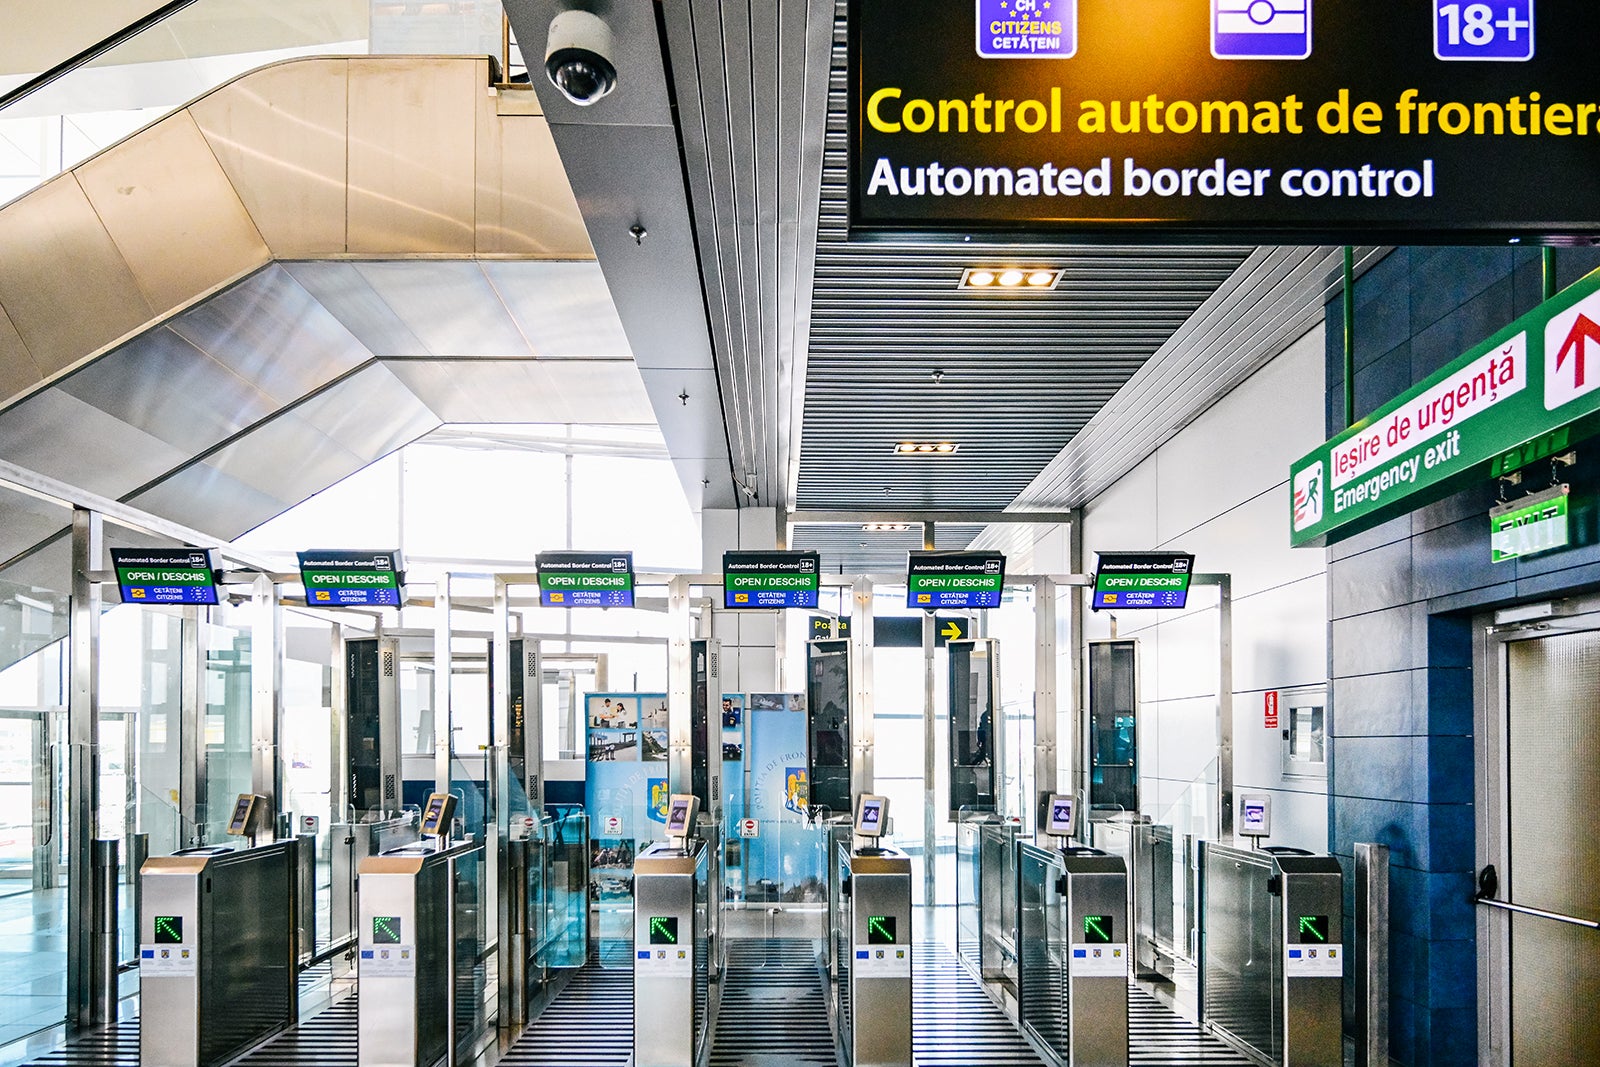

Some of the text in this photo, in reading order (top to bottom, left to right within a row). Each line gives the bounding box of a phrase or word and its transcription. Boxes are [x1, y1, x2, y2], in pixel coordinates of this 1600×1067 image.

[1016, 0, 1036, 11] CH
[990, 21, 1062, 34] CITIZENS
[1439, 4, 1528, 46] 18+
[867, 88, 1600, 136] Control automat de frontier
[866, 158, 1434, 197] Automated border control
[1335, 346, 1514, 478] Ieșire de urgență
[1334, 454, 1420, 514] Emergency
[1424, 430, 1460, 469] exit
[1499, 506, 1558, 558] EXIT
[127, 572, 155, 580] OPEN
[162, 572, 206, 581] DESCHIS
[548, 577, 575, 585] OPEN
[582, 577, 625, 585] DESCHIS
[953, 579, 995, 587] DESCHIS
[1106, 578, 1182, 587] OPEN / DESCHIS
